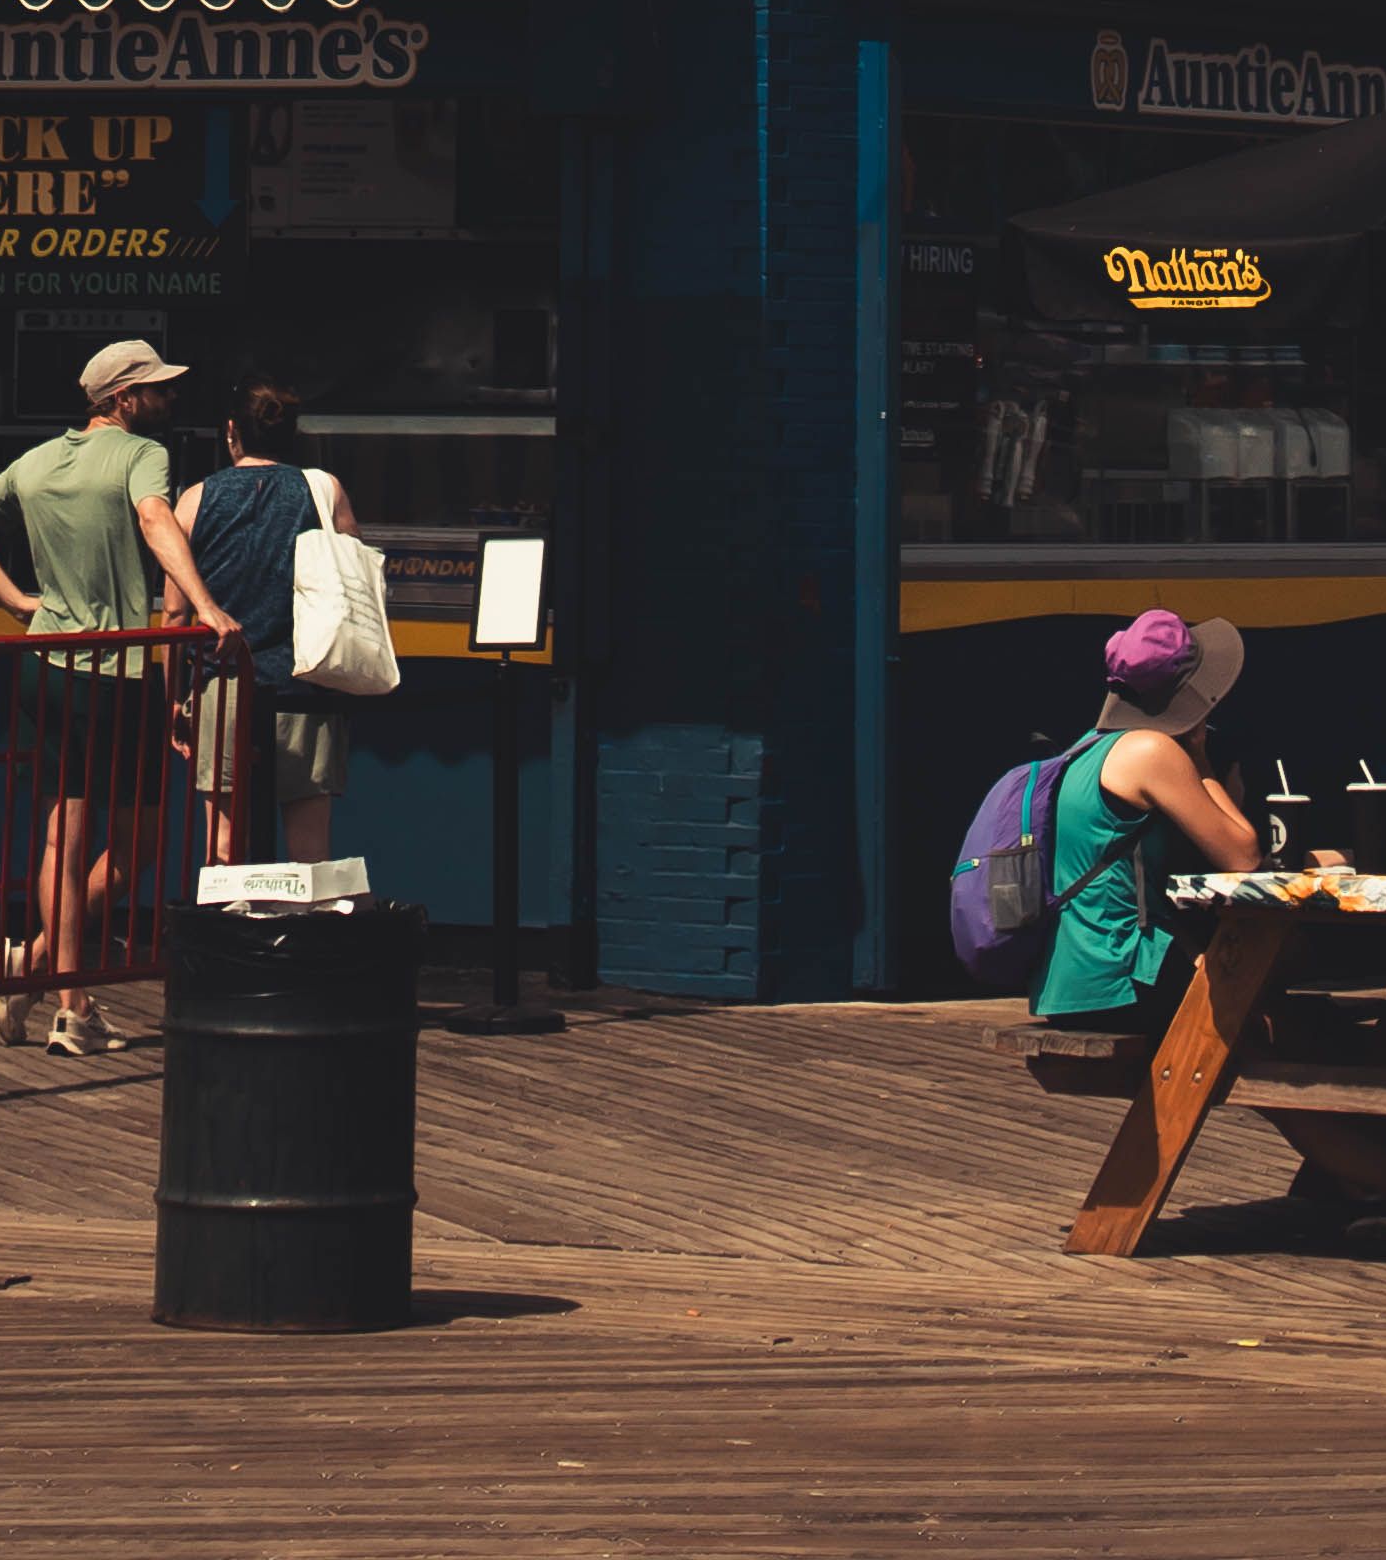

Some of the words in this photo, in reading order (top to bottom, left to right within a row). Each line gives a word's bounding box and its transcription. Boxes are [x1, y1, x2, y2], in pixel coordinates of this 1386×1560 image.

[91, 115, 174, 162] UP
[30, 226, 171, 258] ORDERS
[909, 244, 974, 274] HIRING
[1102, 245, 1271, 294] Nathan's
[14, 272, 63, 295] FOR
[68, 271, 141, 295] YOUR
[145, 271, 223, 295] NAME
